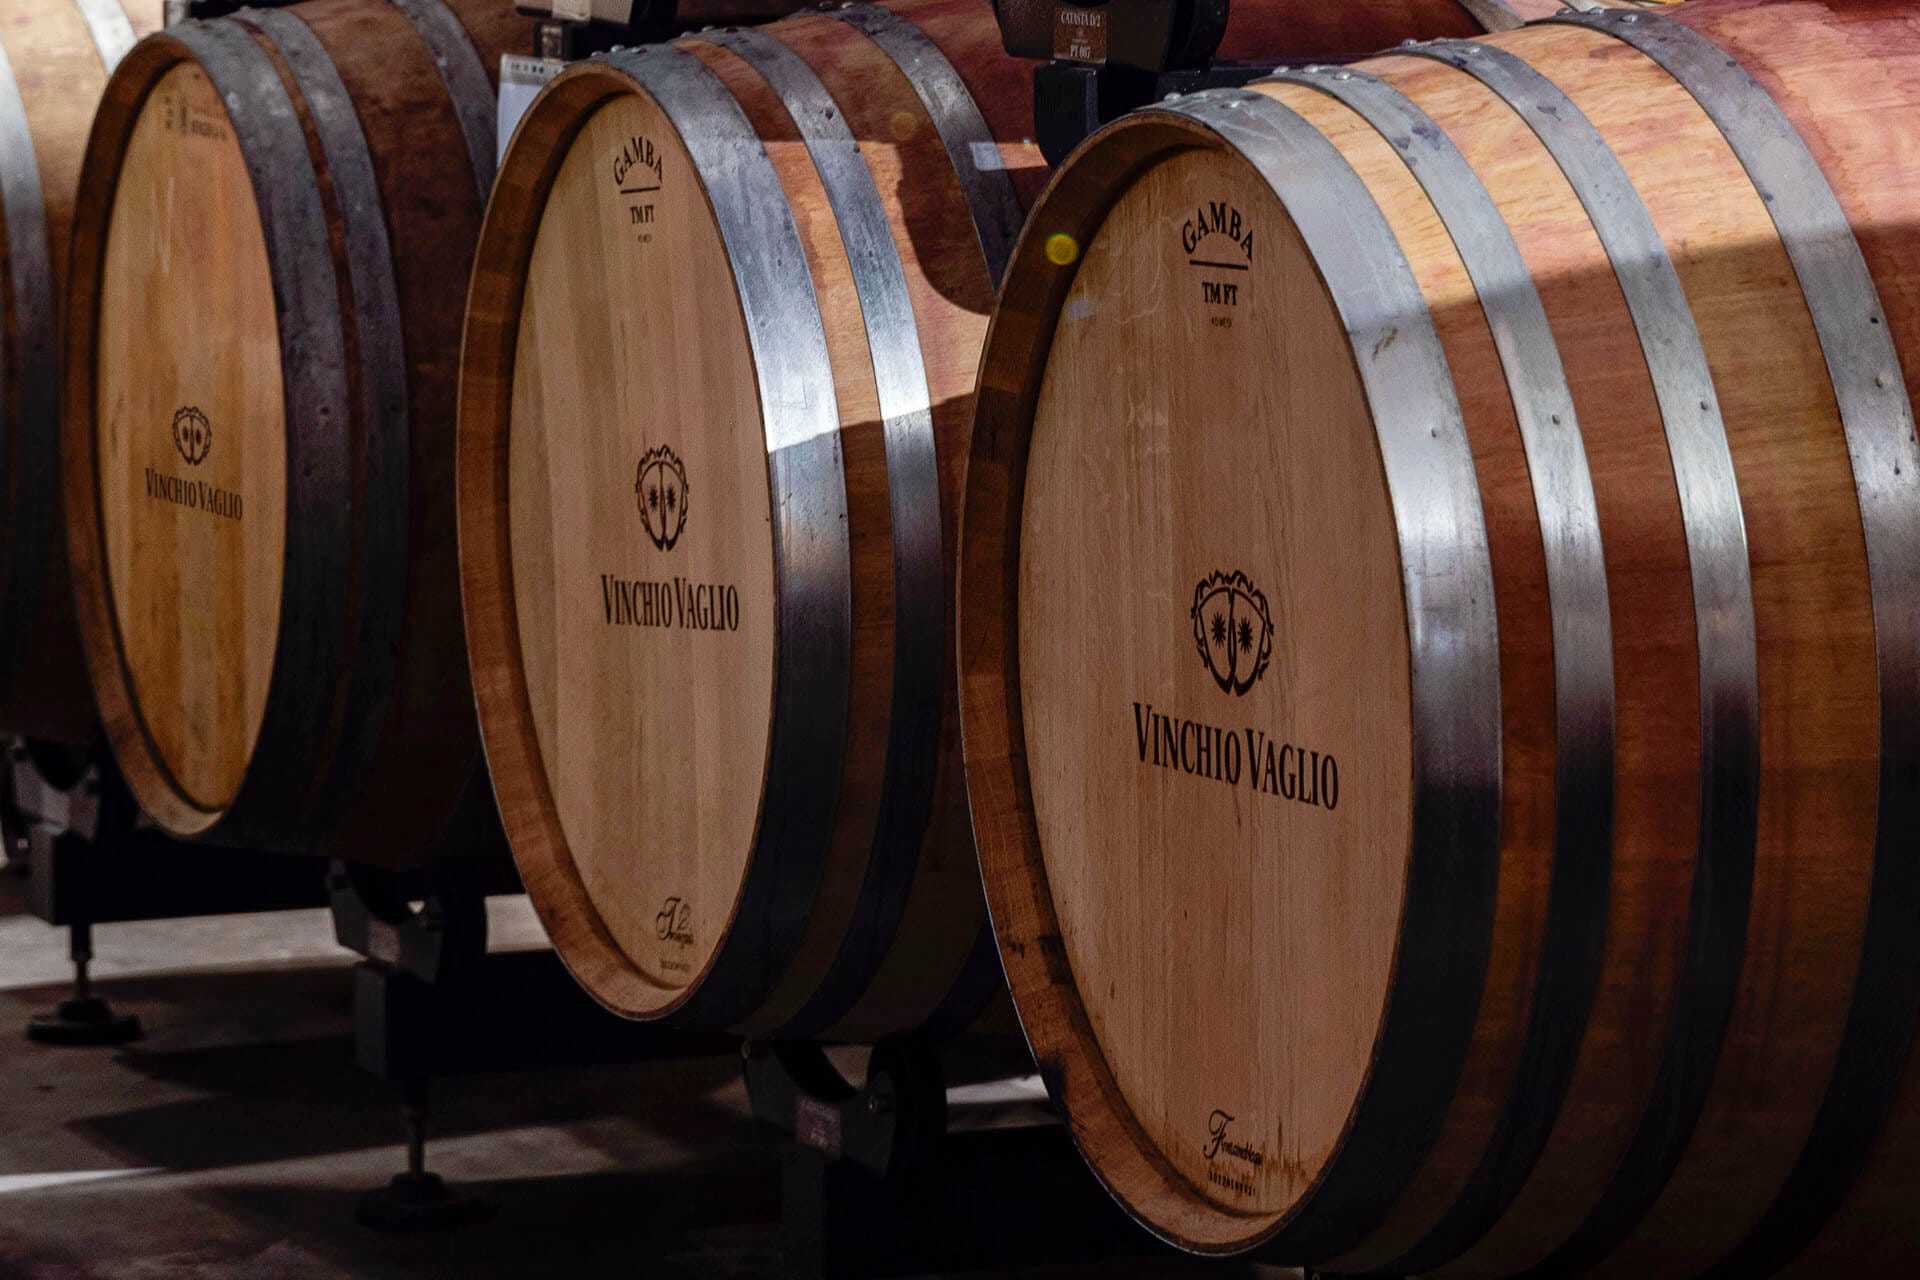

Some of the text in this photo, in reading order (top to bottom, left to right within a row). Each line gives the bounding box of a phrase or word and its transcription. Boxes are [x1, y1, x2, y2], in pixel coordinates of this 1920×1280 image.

[1061, 11, 1089, 26] CATASTA
[1070, 44, 1078, 57] PT
[614, 136, 663, 186] GAMBA
[1182, 200, 1254, 265] GAMBA
[145, 467, 243, 521] VINCHIO VAGLIO
[601, 574, 740, 632] VINCHIO VAGLIO
[1133, 702, 1339, 811] VINCHIO VAGLIO
